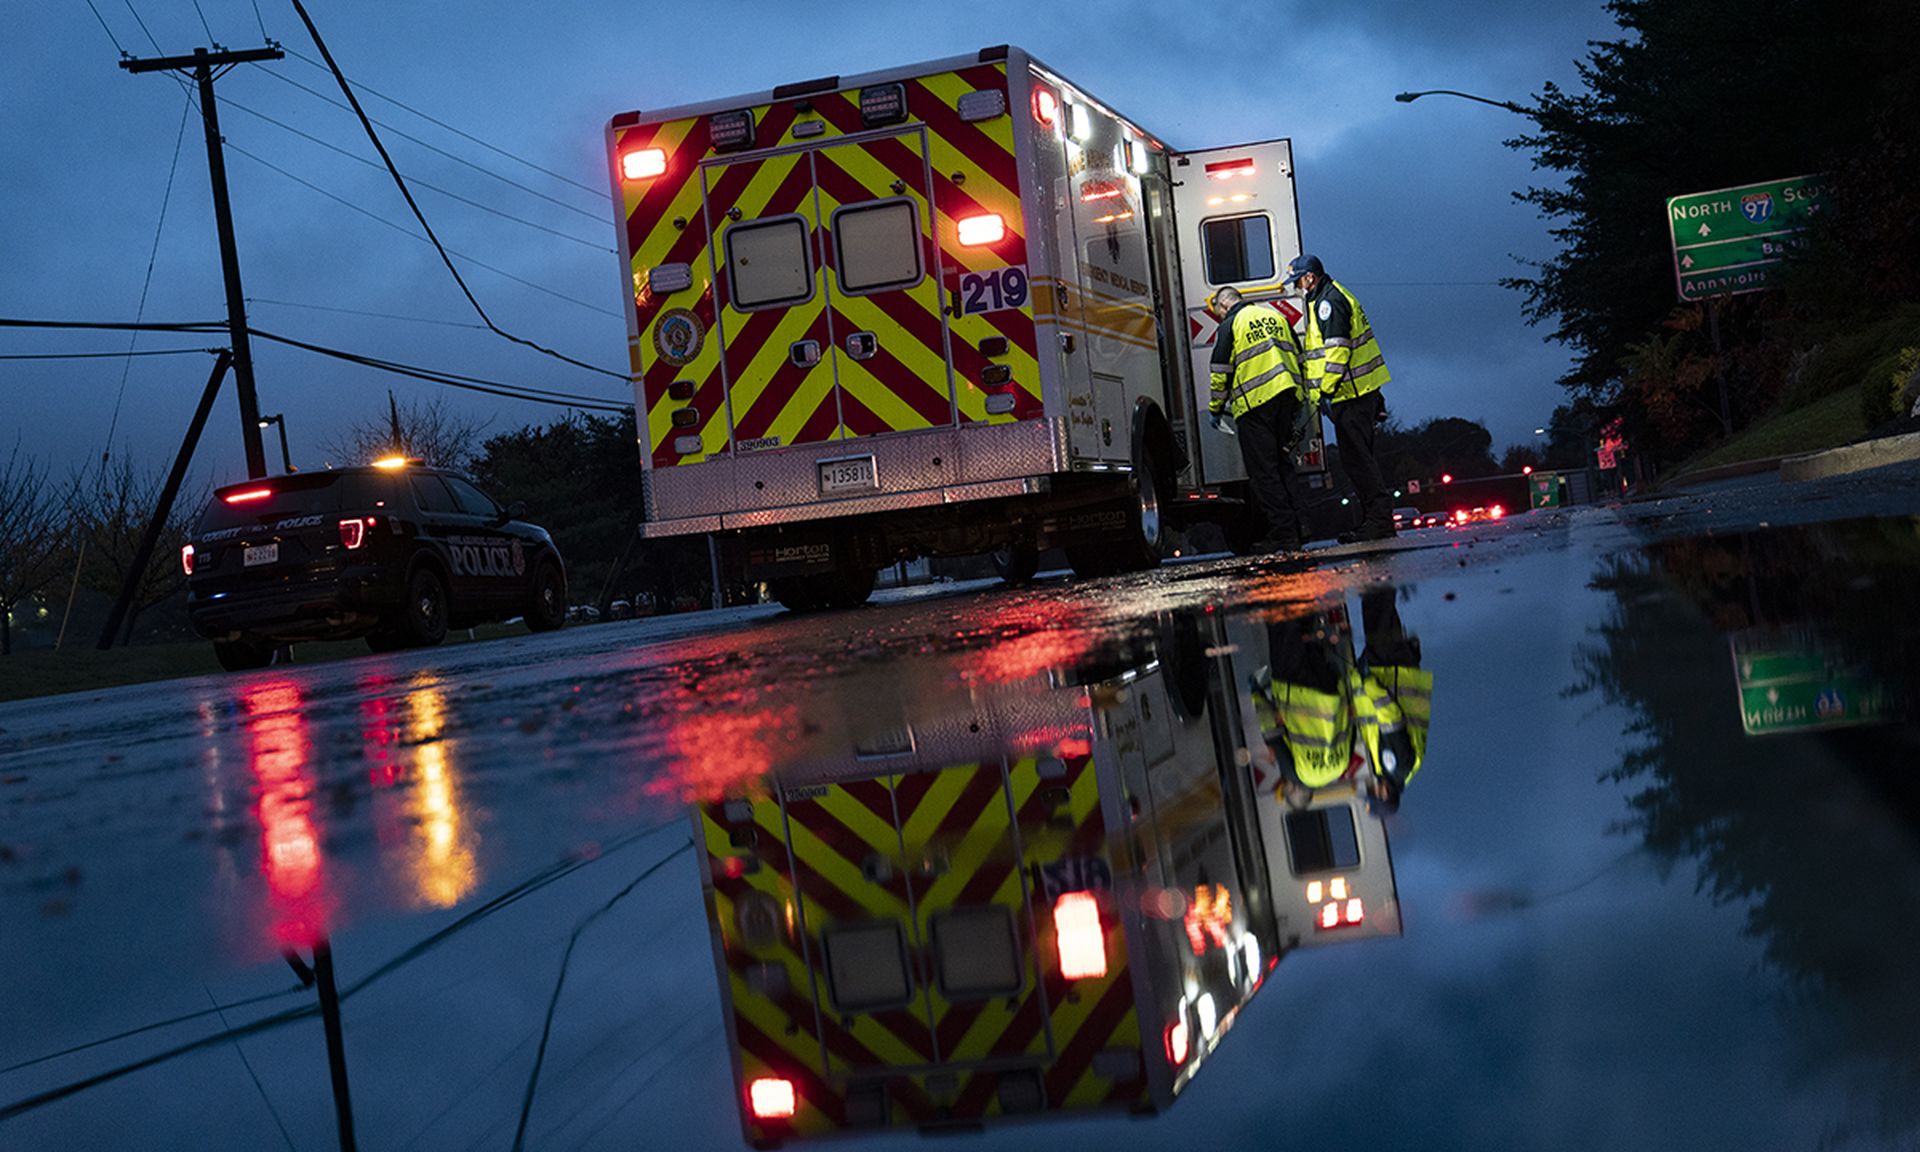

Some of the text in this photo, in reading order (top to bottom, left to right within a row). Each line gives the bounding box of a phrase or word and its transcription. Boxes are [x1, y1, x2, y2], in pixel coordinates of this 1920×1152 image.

[1673, 200, 1731, 221] NORTH
[1744, 199, 1770, 219] 97
[962, 267, 1027, 315] 219
[1249, 316, 1277, 330] AACO
[1246, 328, 1266, 344] FIRE
[275, 514, 324, 531] POLICE
[775, 543, 830, 557] Horton
[447, 544, 517, 577] POLICE
